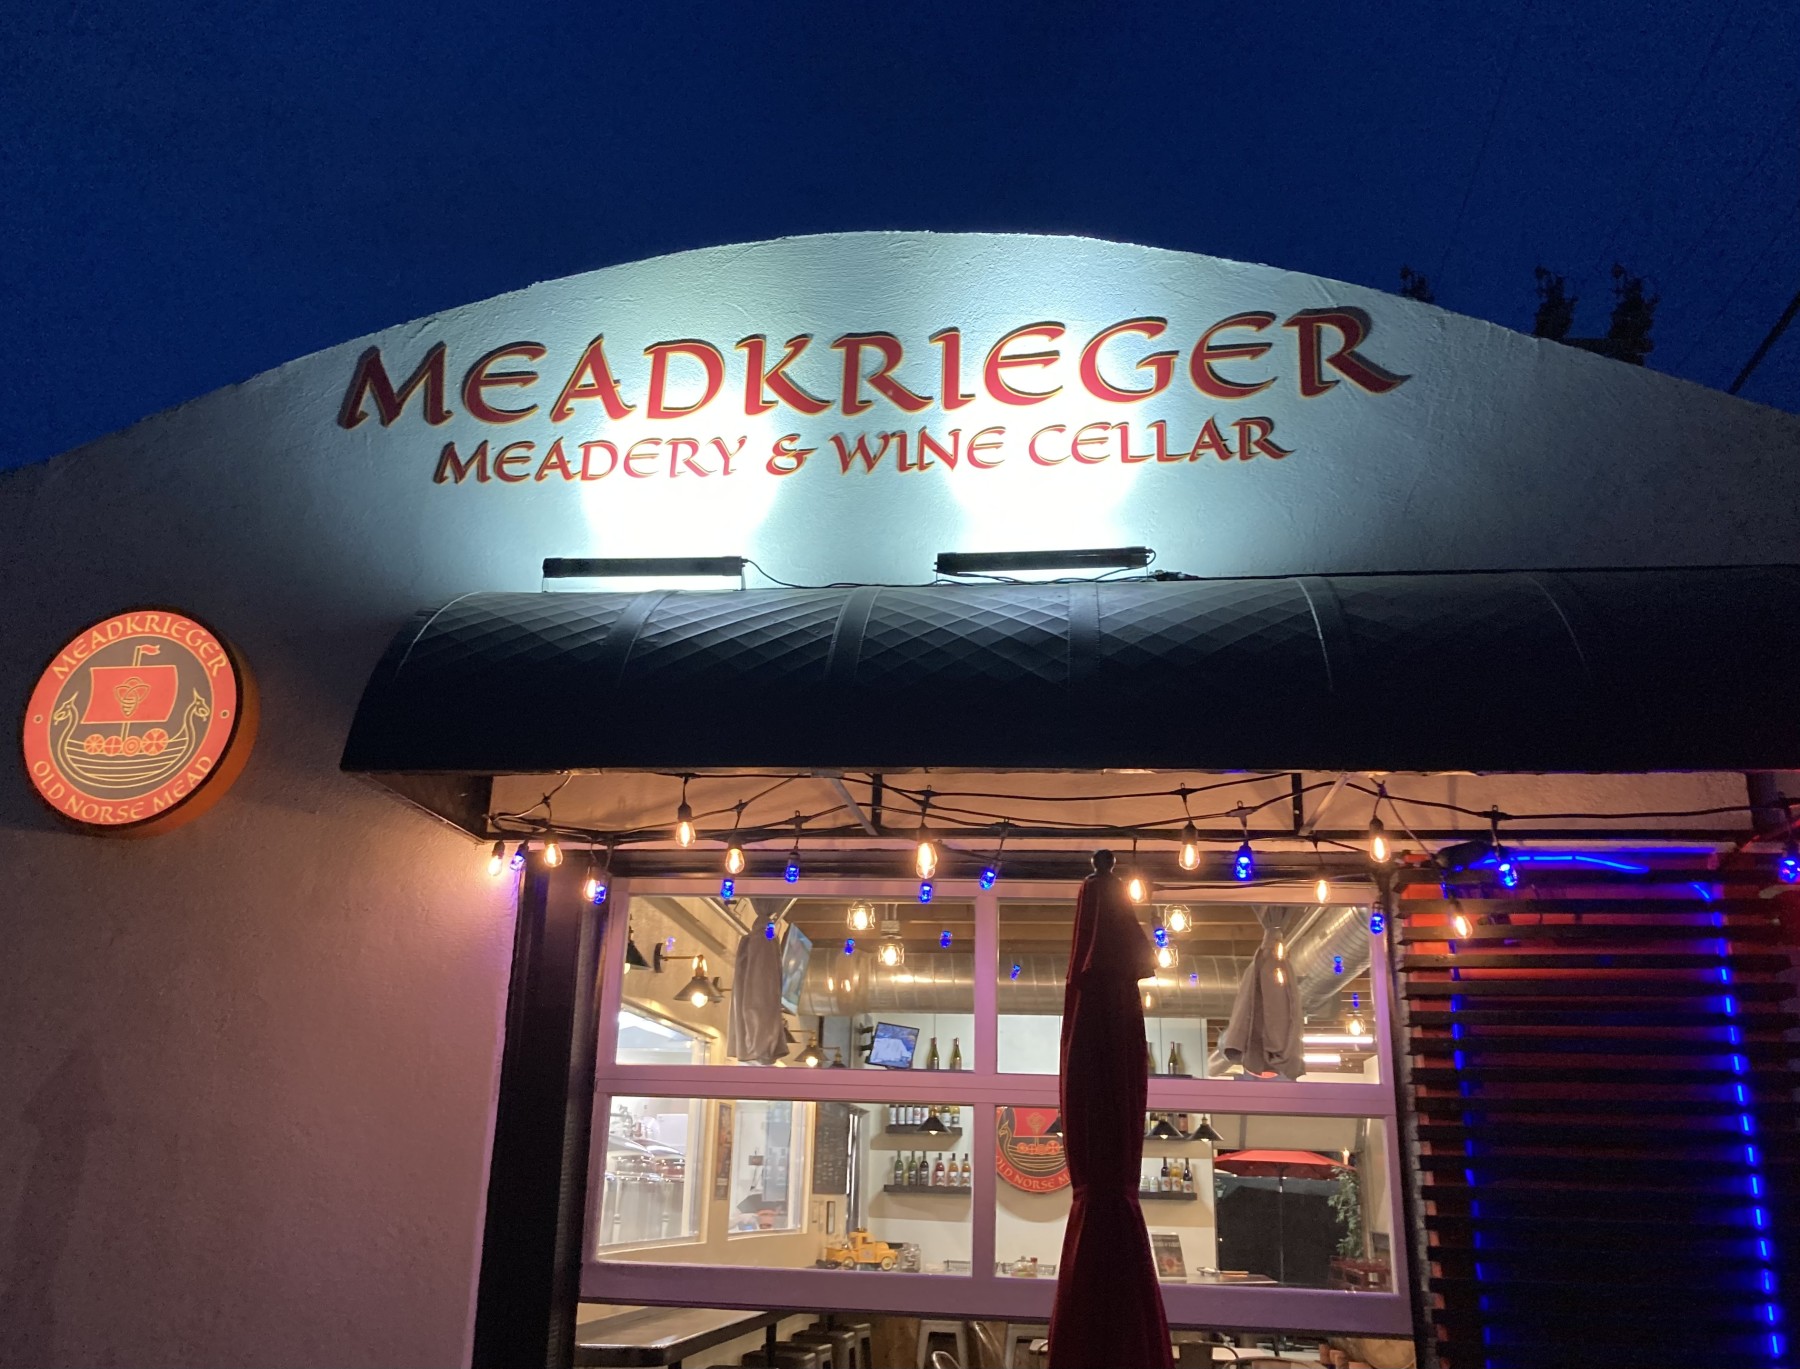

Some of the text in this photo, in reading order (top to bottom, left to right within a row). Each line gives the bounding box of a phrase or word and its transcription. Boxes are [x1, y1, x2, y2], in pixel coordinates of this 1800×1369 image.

[337, 305, 1412, 430] MEADKRIEGER
[432, 414, 1297, 485] MEADERY & WINE CELLAR
[52, 614, 228, 681] MEADKRIEGER
[33, 755, 213, 823] OLD NORSE MEAD
[1013, 1175, 1056, 1190] NORSE
